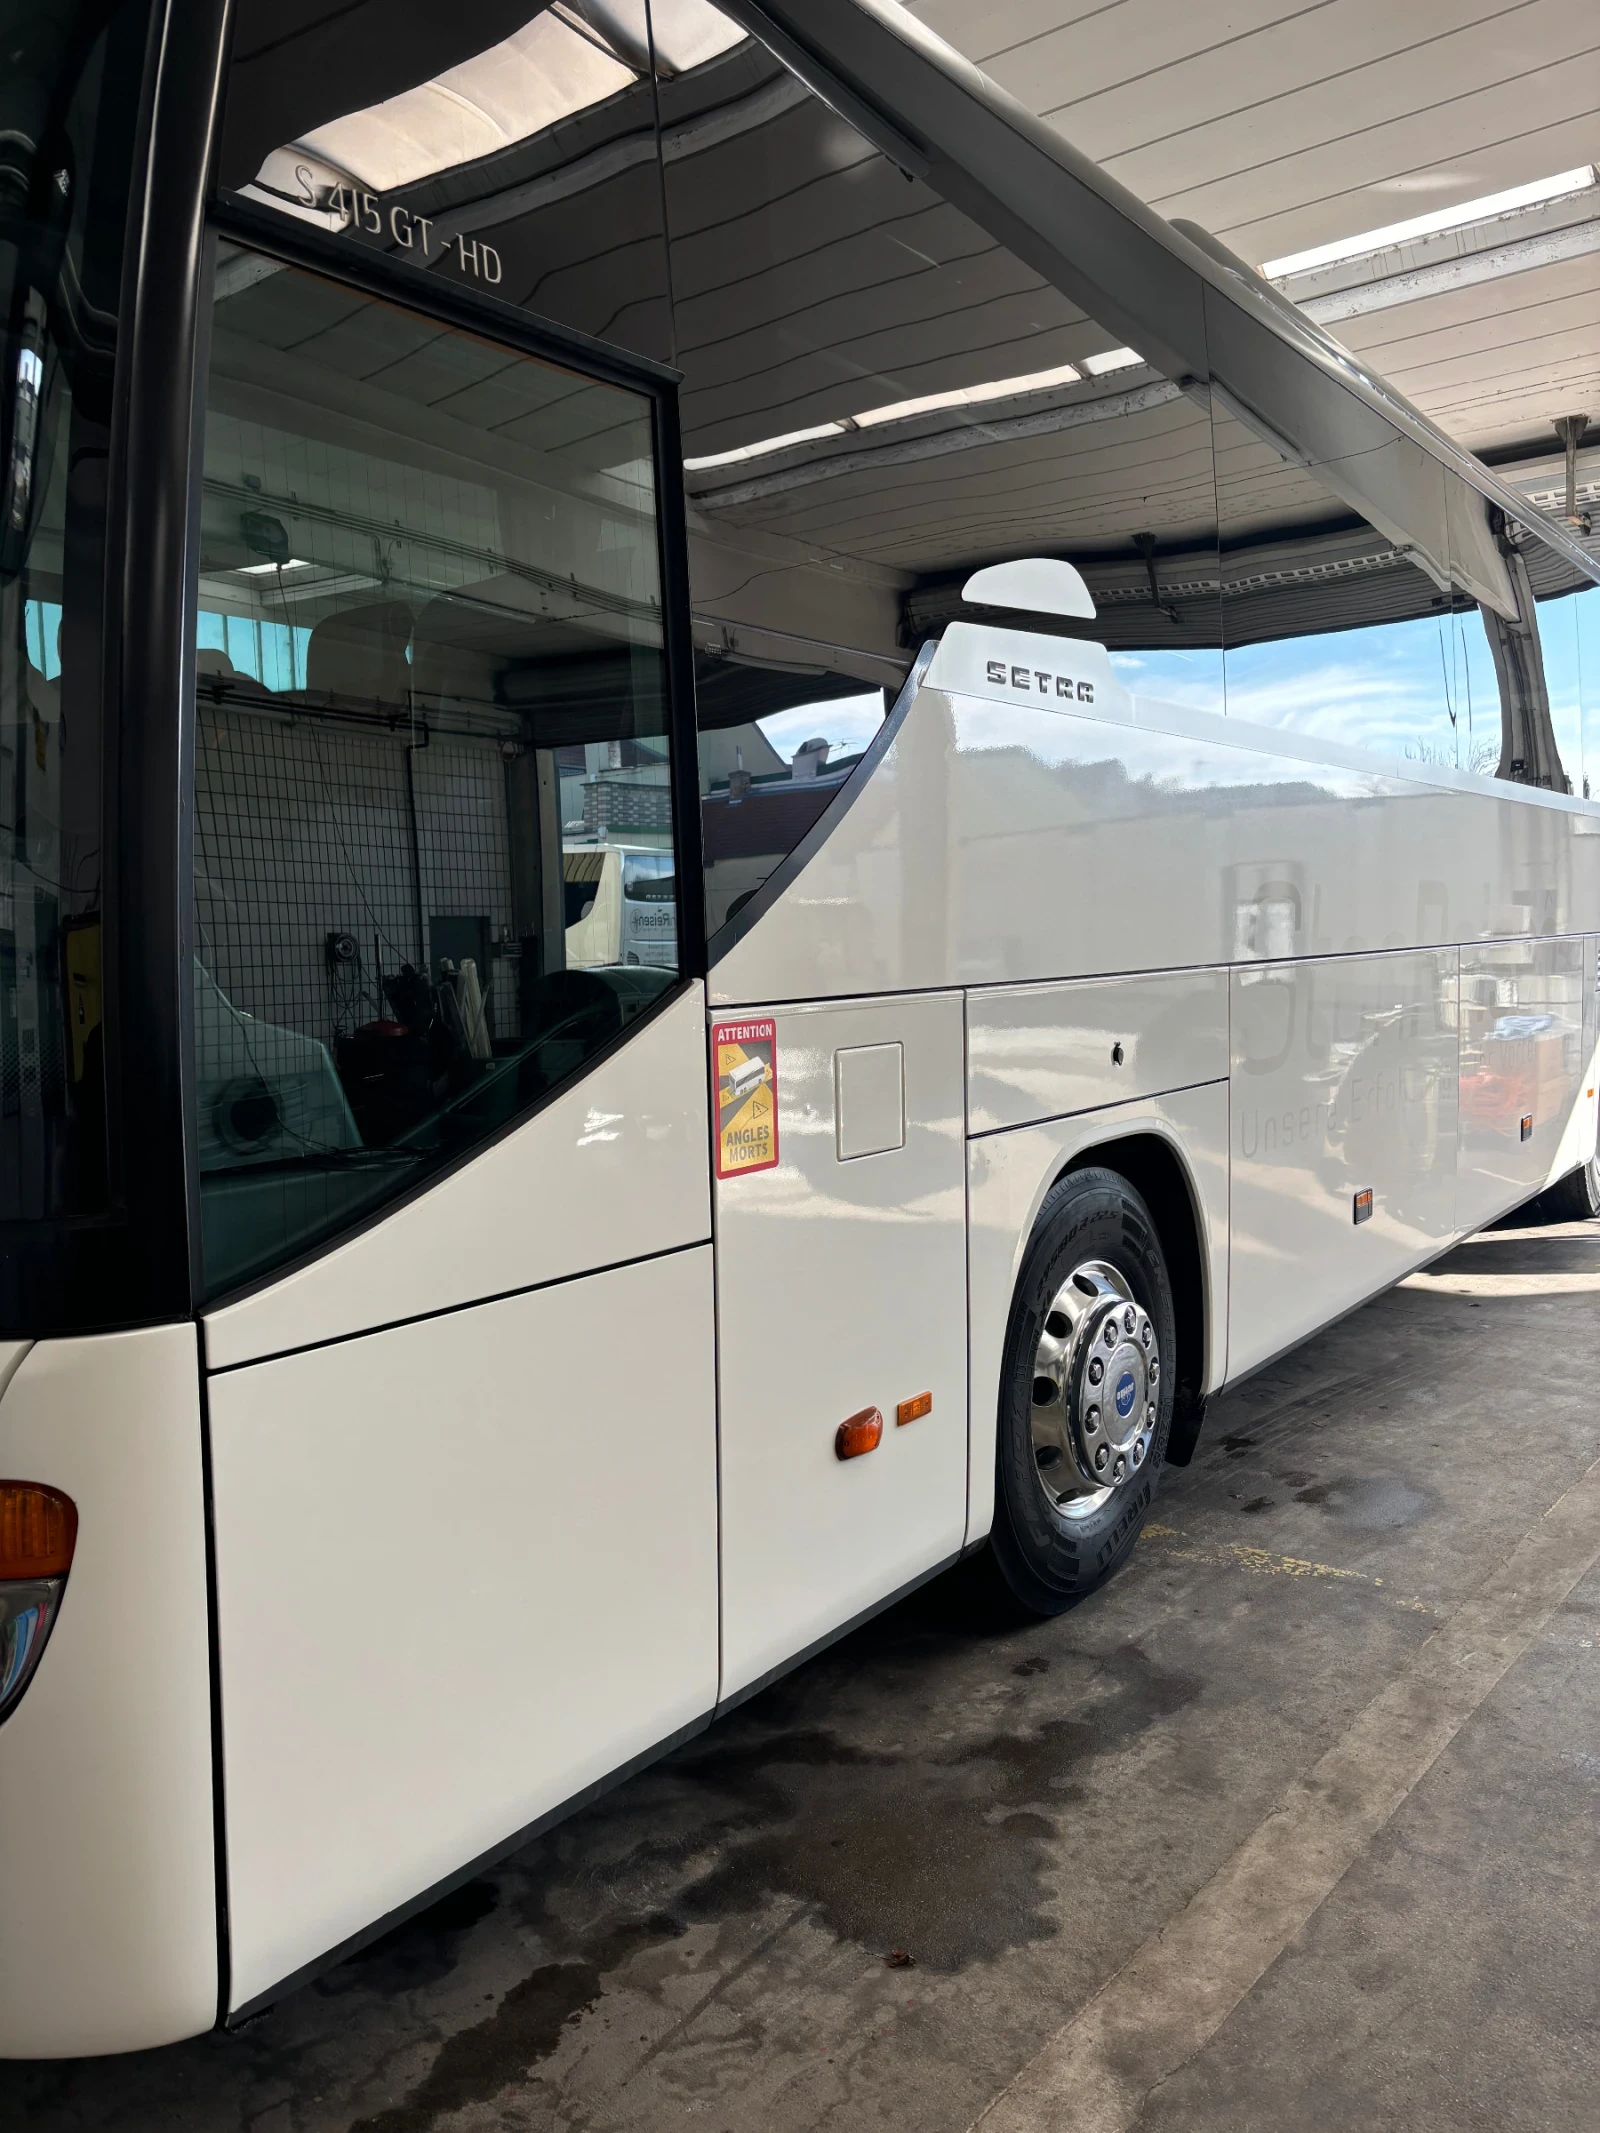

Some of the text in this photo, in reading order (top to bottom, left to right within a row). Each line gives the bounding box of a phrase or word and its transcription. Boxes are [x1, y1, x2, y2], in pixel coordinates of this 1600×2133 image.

[295, 164, 317, 208] S
[328, 181, 382, 235] 415
[987, 661, 1094, 703] SETRA
[718, 1024, 772, 1041] ATTENTION
[726, 1125, 769, 1147] ANGLES
[729, 1143, 768, 1163] MORTS
